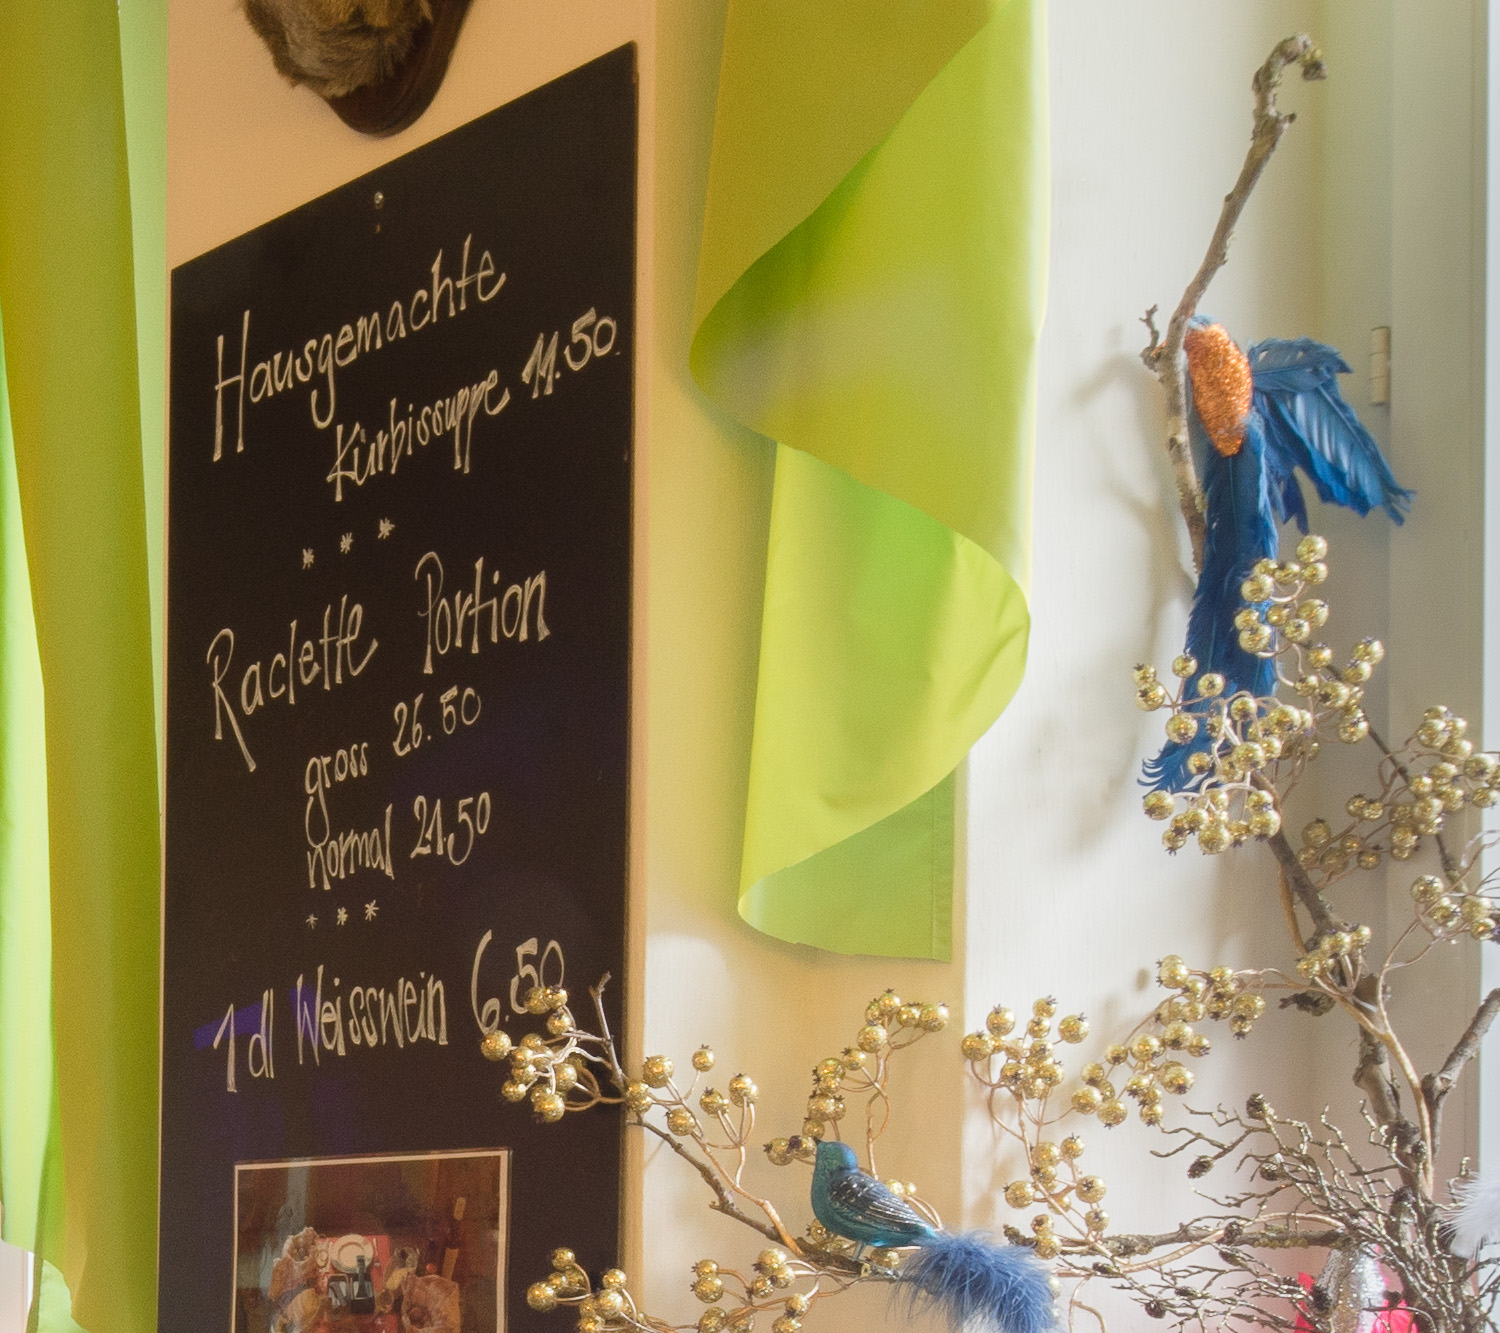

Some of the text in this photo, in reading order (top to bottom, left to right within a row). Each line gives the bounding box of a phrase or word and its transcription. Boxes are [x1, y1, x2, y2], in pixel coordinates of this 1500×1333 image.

[213, 233, 507, 461] Hausgemachte
[327, 370, 510, 501] Kürbissuppe
[207, 551, 551, 772] Raclette Portion
[304, 743, 369, 848] gross
[306, 804, 395, 890] normal
[297, 965, 448, 1067] Weisswein
